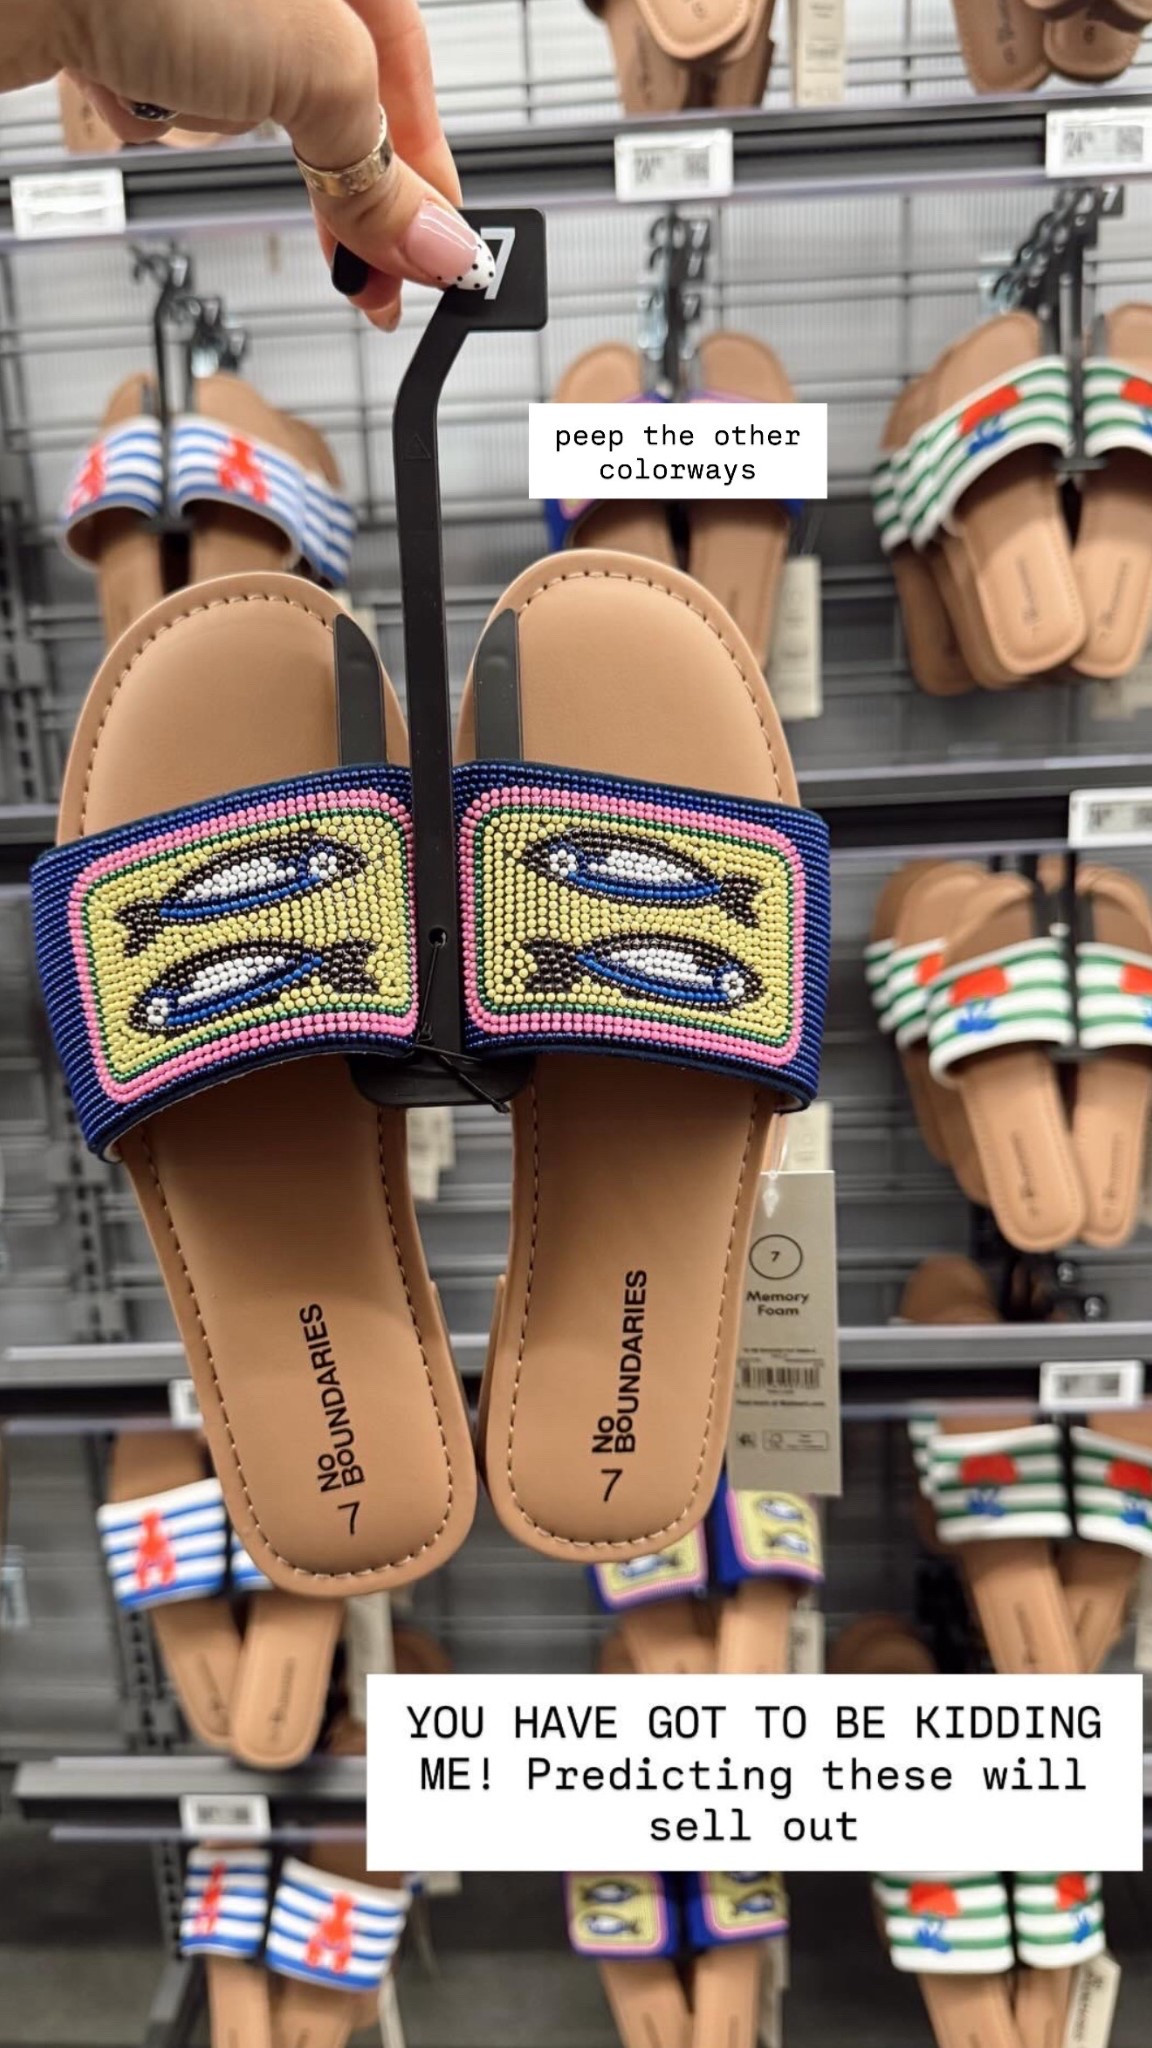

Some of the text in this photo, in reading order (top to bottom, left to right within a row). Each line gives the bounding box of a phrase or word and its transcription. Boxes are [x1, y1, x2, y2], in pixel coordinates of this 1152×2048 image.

[480, 227, 516, 300] 7
[772, 1250, 781, 1262] 7
[746, 1291, 810, 1305] Memory
[757, 1304, 800, 1316] Foam
[612, 1268, 648, 1454] BOUNDARIES
[299, 1302, 366, 1488] BOUNDARIES
[600, 1467, 624, 1502] 7
[336, 1500, 361, 1536] 7
